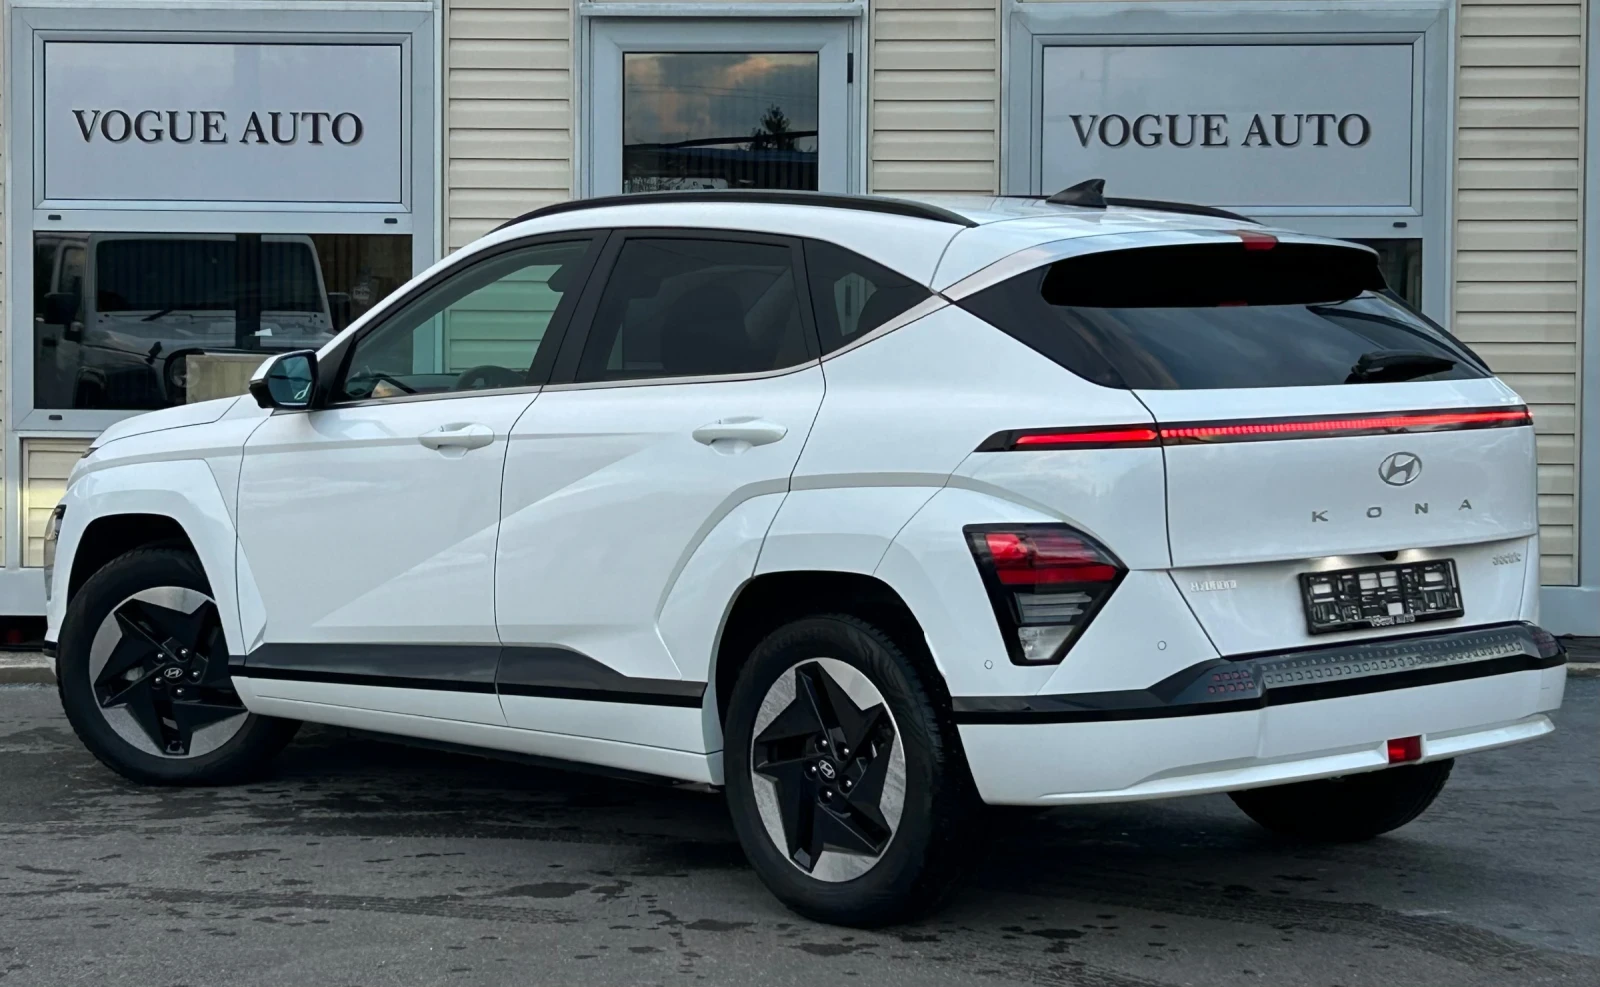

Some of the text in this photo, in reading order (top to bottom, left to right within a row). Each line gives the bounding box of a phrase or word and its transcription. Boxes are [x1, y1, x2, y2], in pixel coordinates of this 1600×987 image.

[72, 109, 364, 145] VOGUE AUTO
[1069, 112, 1371, 148] VOGUE AUTO
[1311, 499, 1472, 523] KONA
